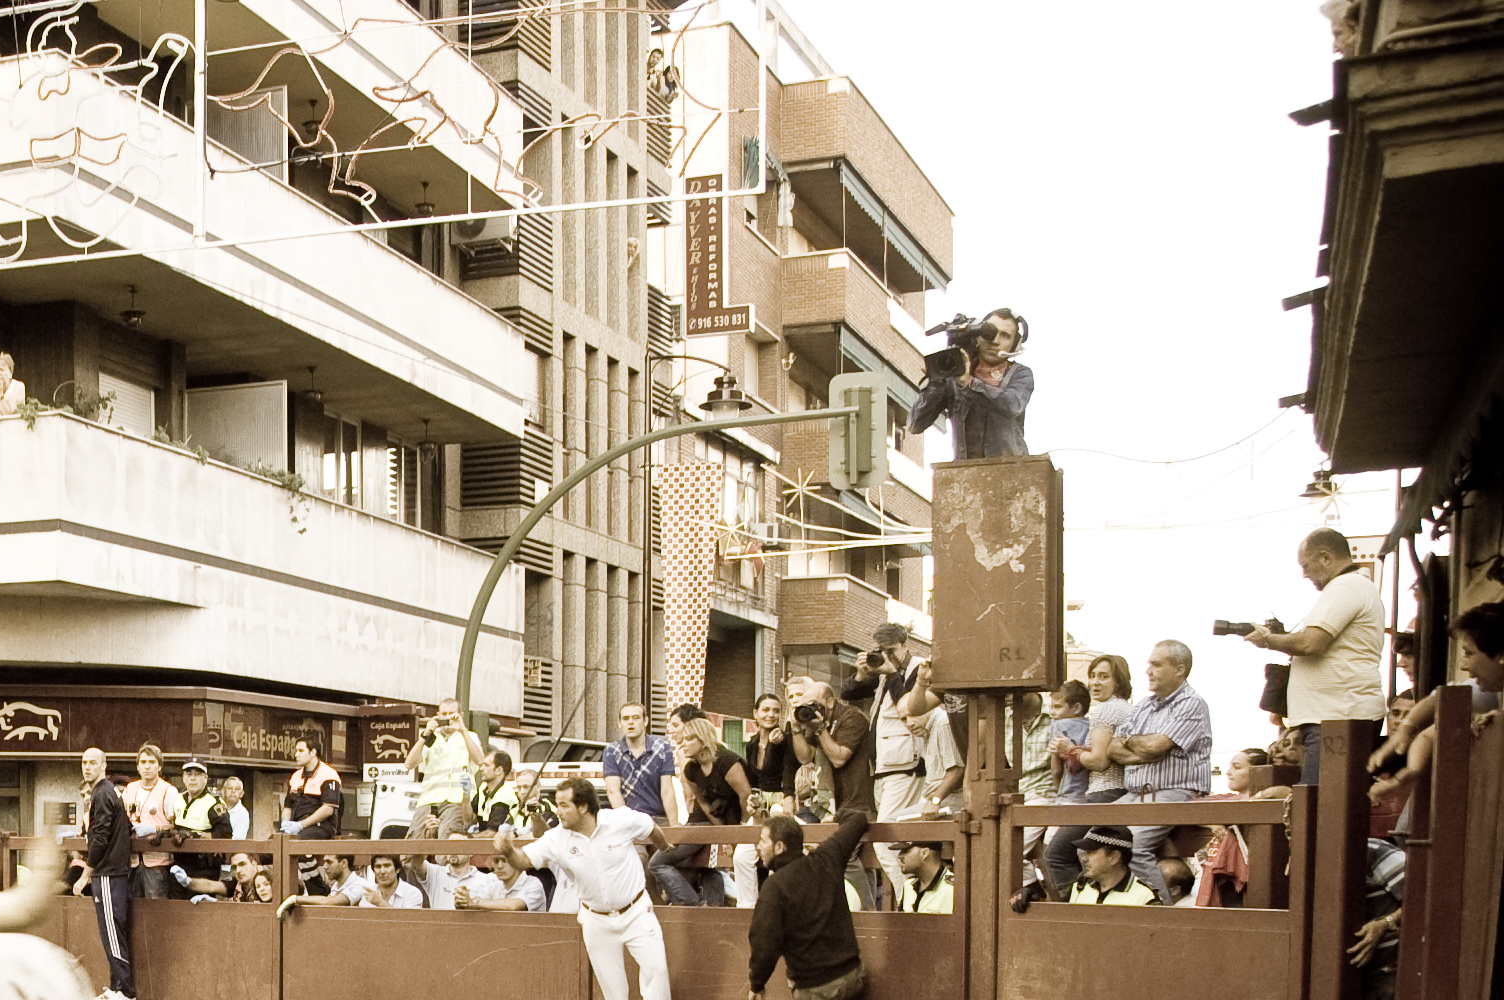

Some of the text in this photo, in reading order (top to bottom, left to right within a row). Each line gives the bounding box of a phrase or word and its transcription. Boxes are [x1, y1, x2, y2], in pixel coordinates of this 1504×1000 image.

[697, 311, 746, 330] 916 530 831
[370, 721, 410, 731] Caja España
[234, 725, 257, 757] Caja
